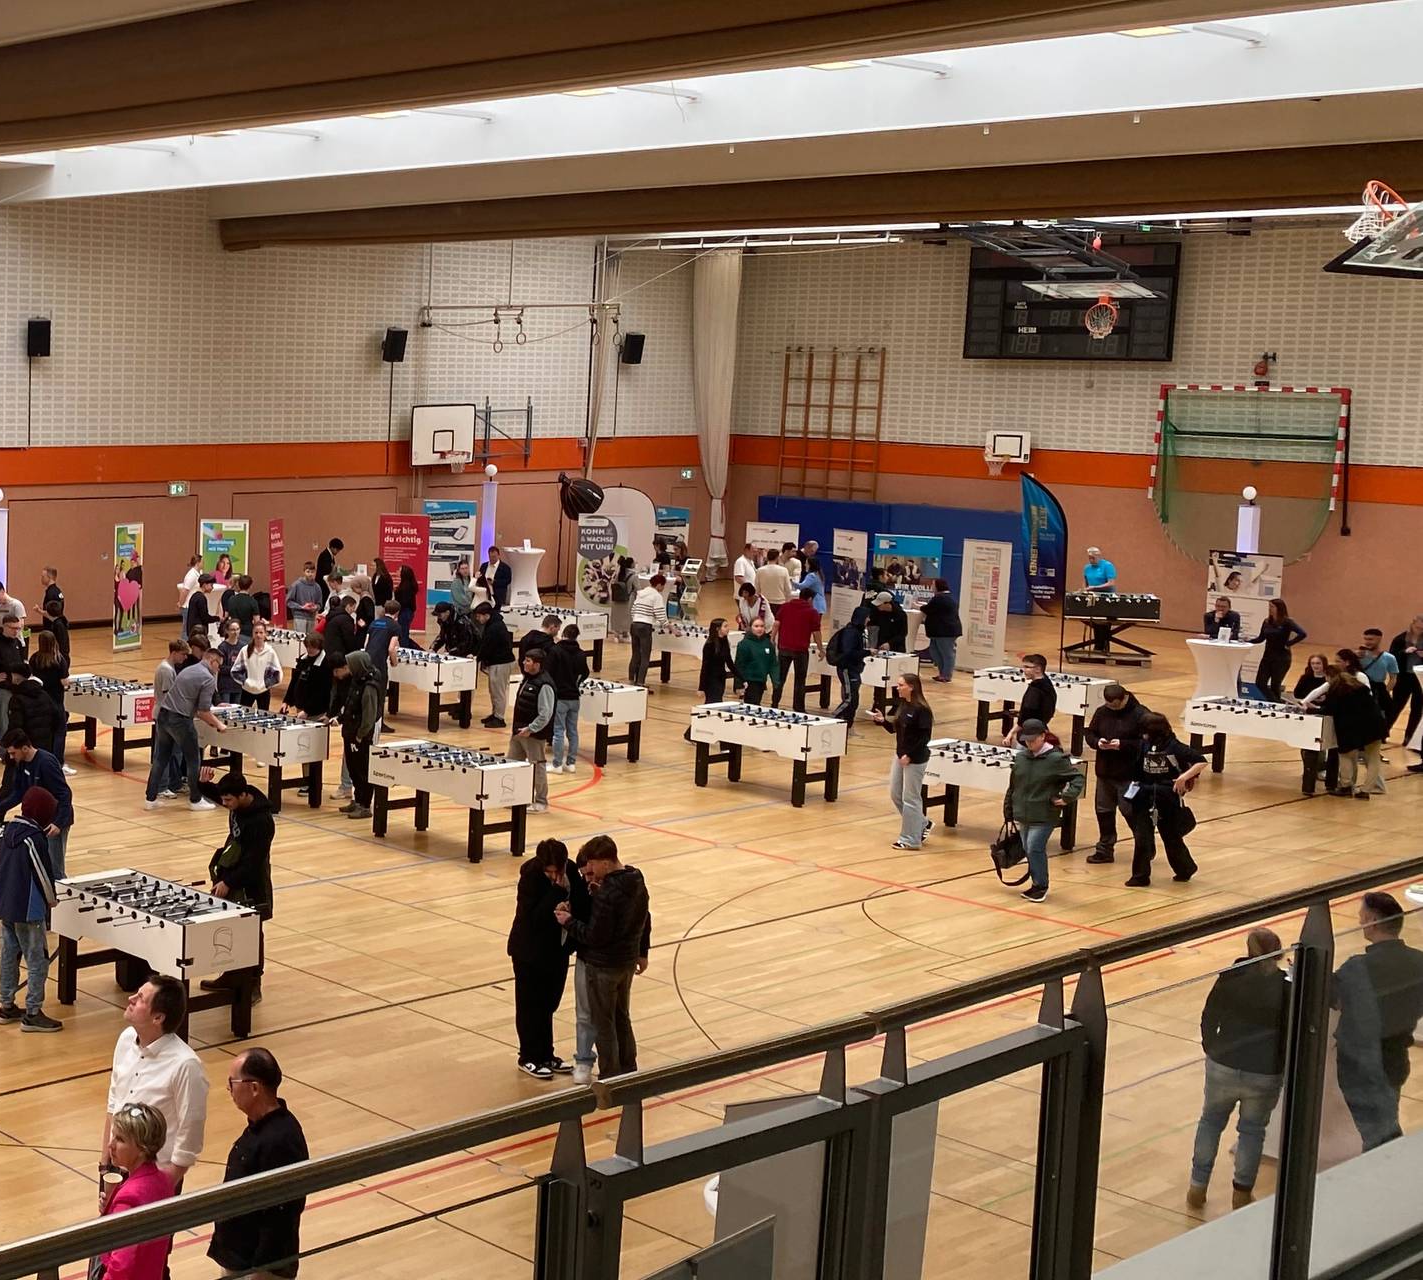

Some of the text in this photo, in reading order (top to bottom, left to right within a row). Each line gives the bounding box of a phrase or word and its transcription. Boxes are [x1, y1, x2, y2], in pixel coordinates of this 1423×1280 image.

[1018, 326, 1037, 334] HEIM
[384, 526, 418, 535] Hier bist
[384, 535, 424, 545] du richtig.
